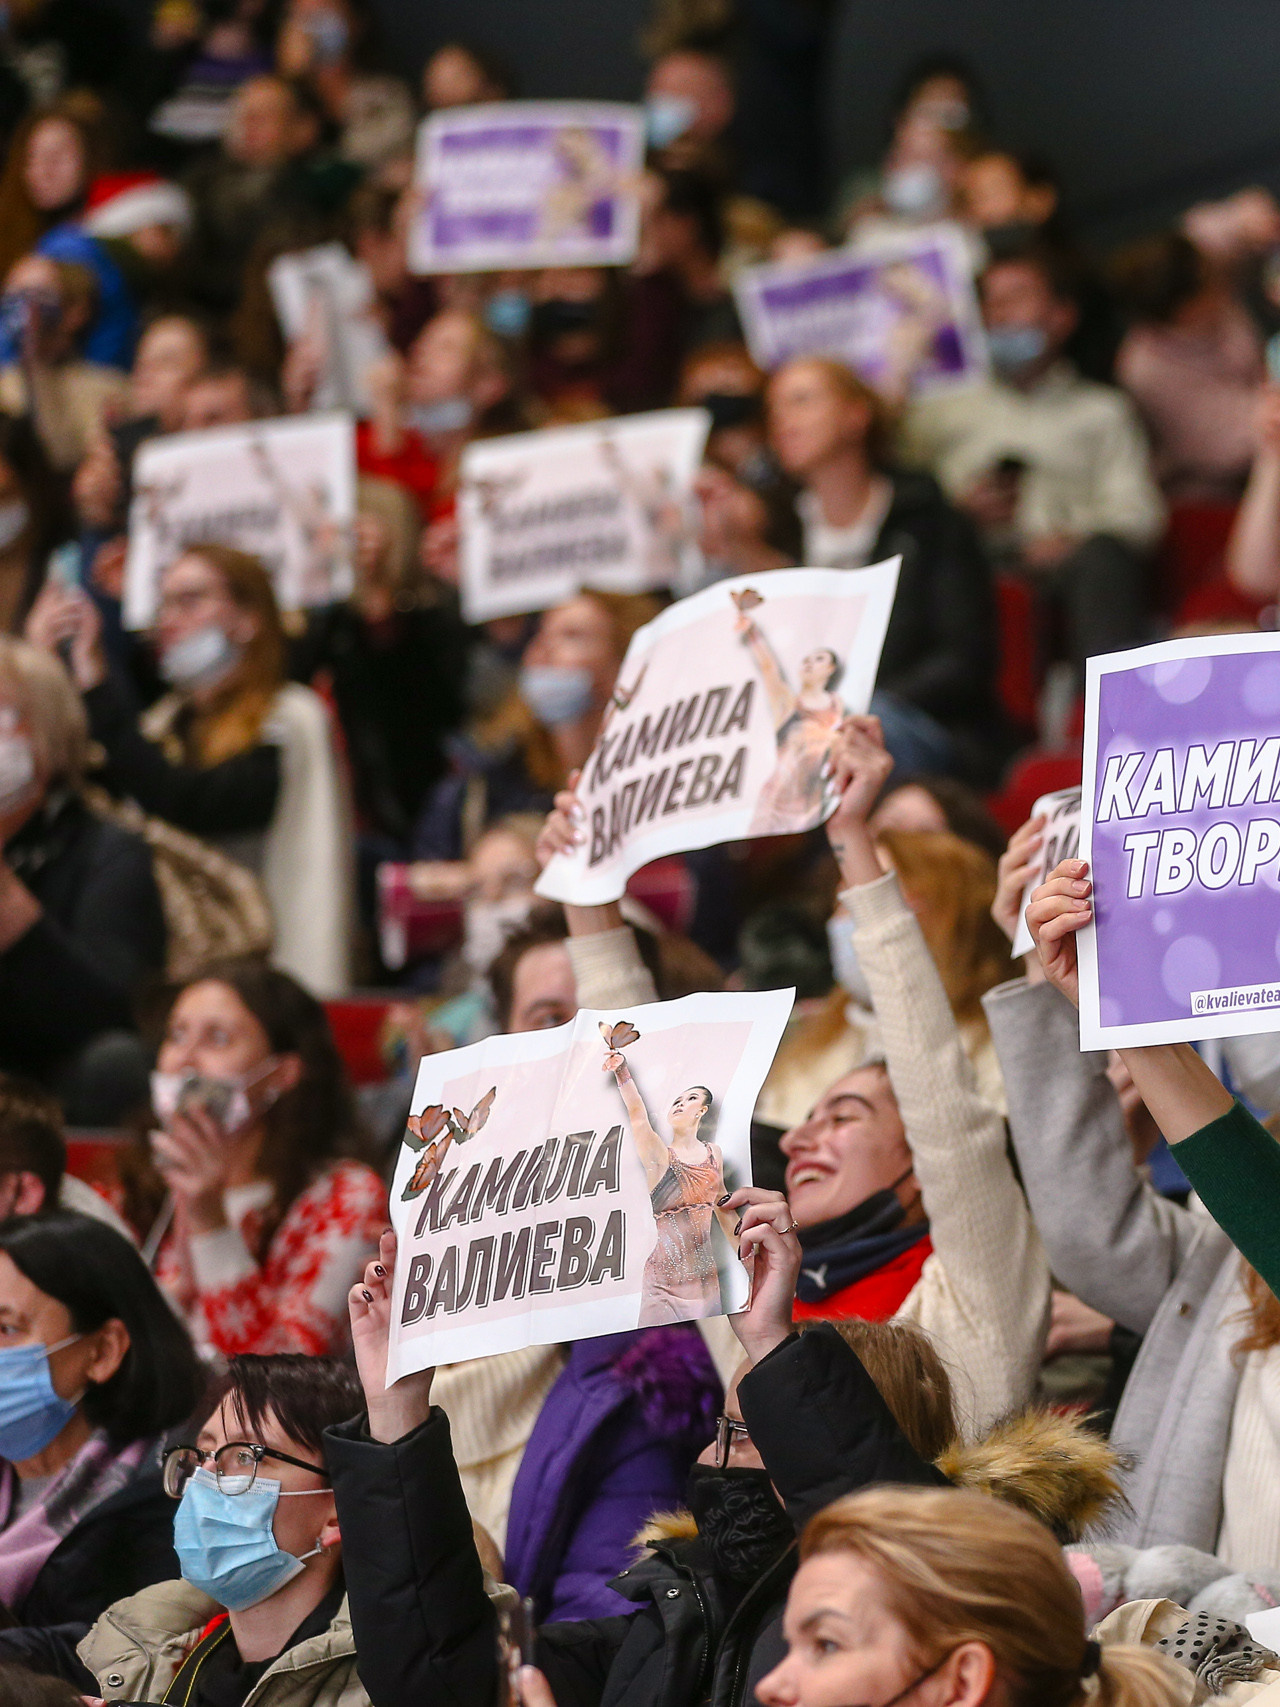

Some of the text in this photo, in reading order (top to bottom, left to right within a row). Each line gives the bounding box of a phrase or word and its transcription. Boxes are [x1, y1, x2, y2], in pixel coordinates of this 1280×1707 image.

[590, 680, 756, 794] КАМИЛА
[589, 746, 749, 868] ВАЛИЕВА
[414, 1125, 625, 1238] КАМИЛА
[400, 1210, 628, 1329] ВАЛИЕВА
